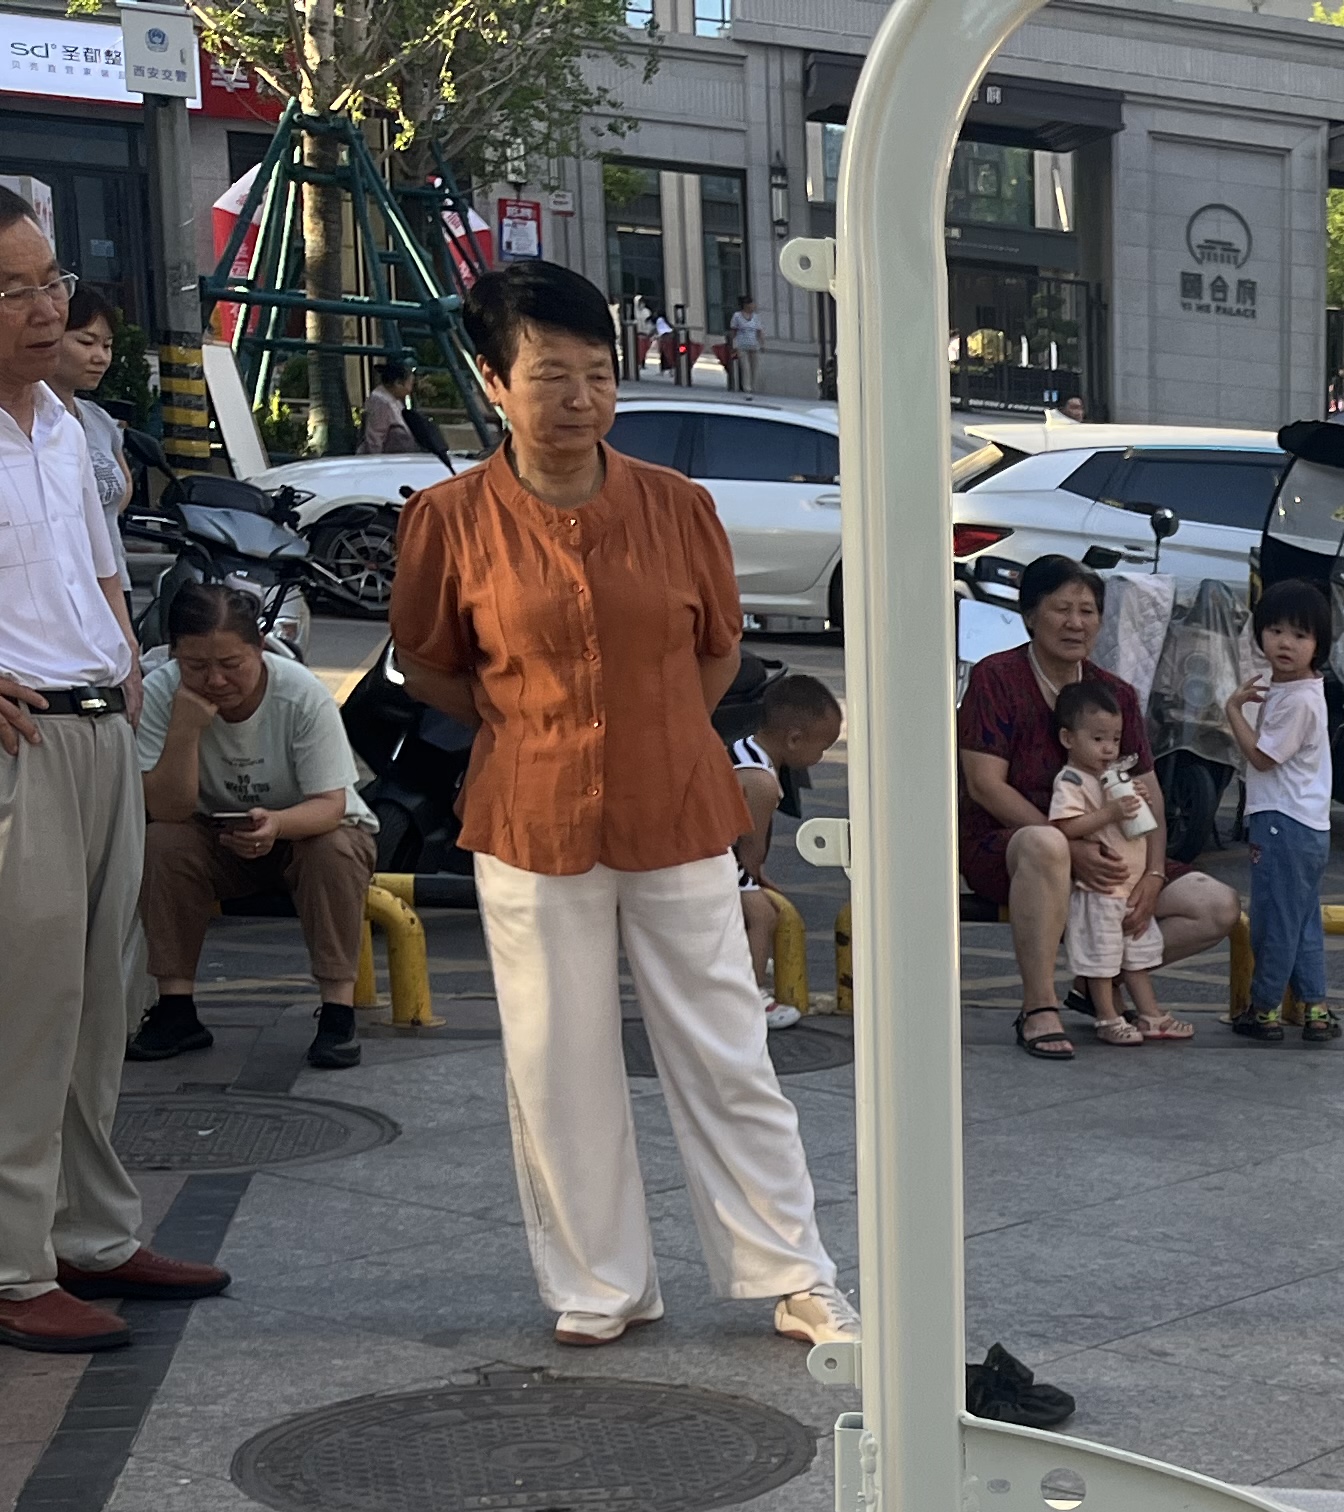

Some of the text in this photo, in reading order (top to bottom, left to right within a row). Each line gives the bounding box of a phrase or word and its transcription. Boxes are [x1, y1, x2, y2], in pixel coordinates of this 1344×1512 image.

[132, 64, 188, 83] 西安交警
[1215, 305, 1257, 319] PALACE
